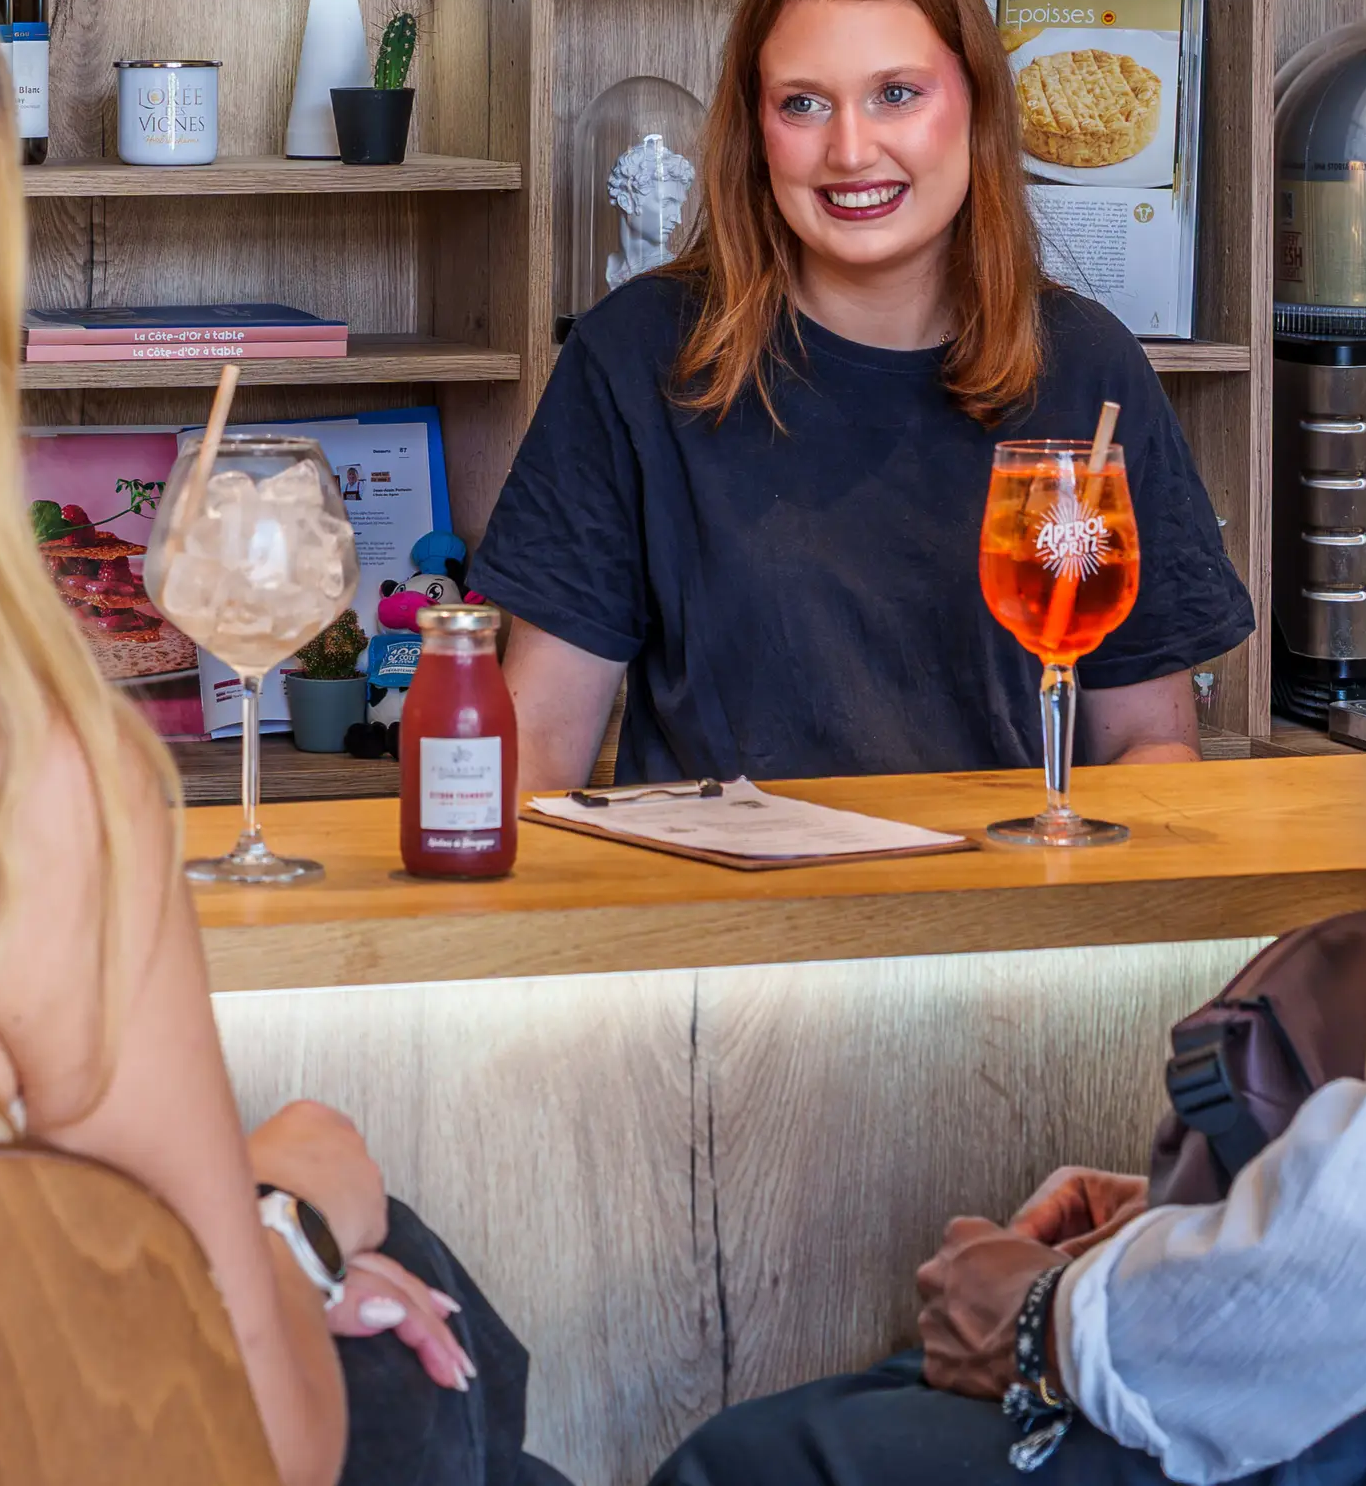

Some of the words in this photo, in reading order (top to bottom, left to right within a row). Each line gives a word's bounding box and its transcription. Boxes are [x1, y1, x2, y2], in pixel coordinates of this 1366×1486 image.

[134, 333, 146, 341] La
[204, 331, 210, 340] à
[212, 330, 245, 341] table
[133, 348, 144, 357] La
[202, 347, 209, 356] à
[211, 345, 244, 356] table
[1037, 515, 1107, 550] APEROL
[1050, 538, 1099, 560] SPRITZ
